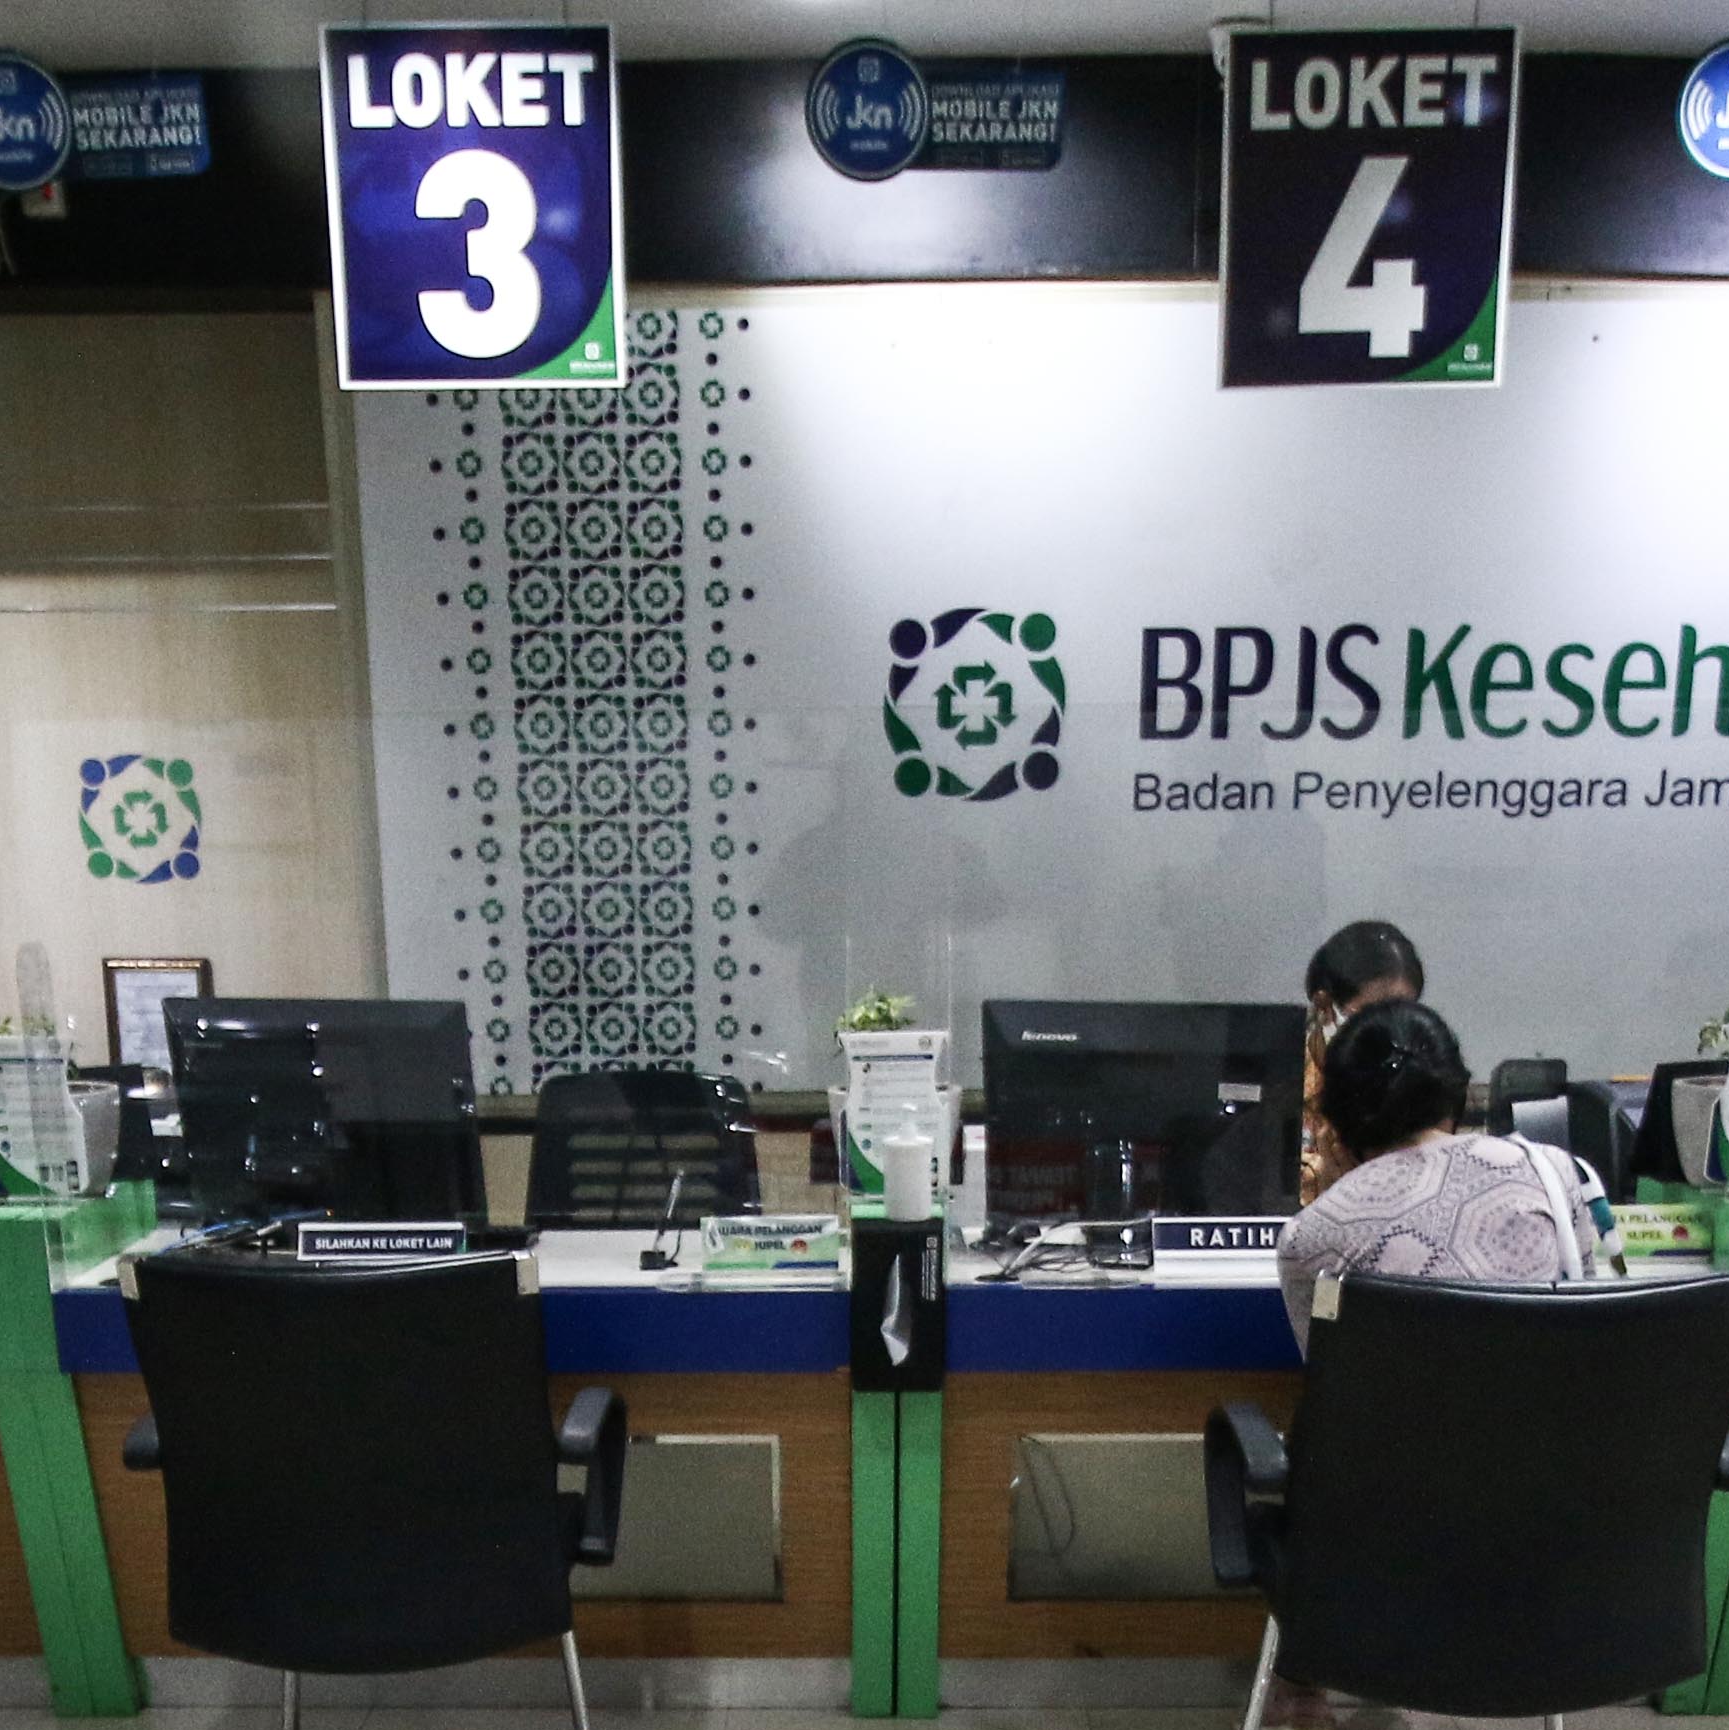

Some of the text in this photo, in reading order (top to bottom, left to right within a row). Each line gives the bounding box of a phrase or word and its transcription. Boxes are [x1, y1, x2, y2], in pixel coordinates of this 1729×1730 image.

[347, 52, 594, 129] LOKET
[1250, 56, 1497, 130] LOKET
[72, 103, 201, 129] MOBILE JKN
[931, 99, 1059, 121] MOBILE JKN
[75, 126, 203, 151] SEKARANG!
[931, 122, 1056, 143] SEKARANG!
[415, 148, 542, 359] 3
[1298, 156, 1426, 359] 4
[1139, 622, 1382, 742] BPJS
[1133, 772, 1275, 813] Badan
[1292, 771, 1628, 820] Penyelenggara
[315, 1237, 453, 1250] SILAHKAN KE LOKET LAIN
[754, 1224, 822, 1238] PELANGGAN
[1189, 1228, 1275, 1247] RATIH
